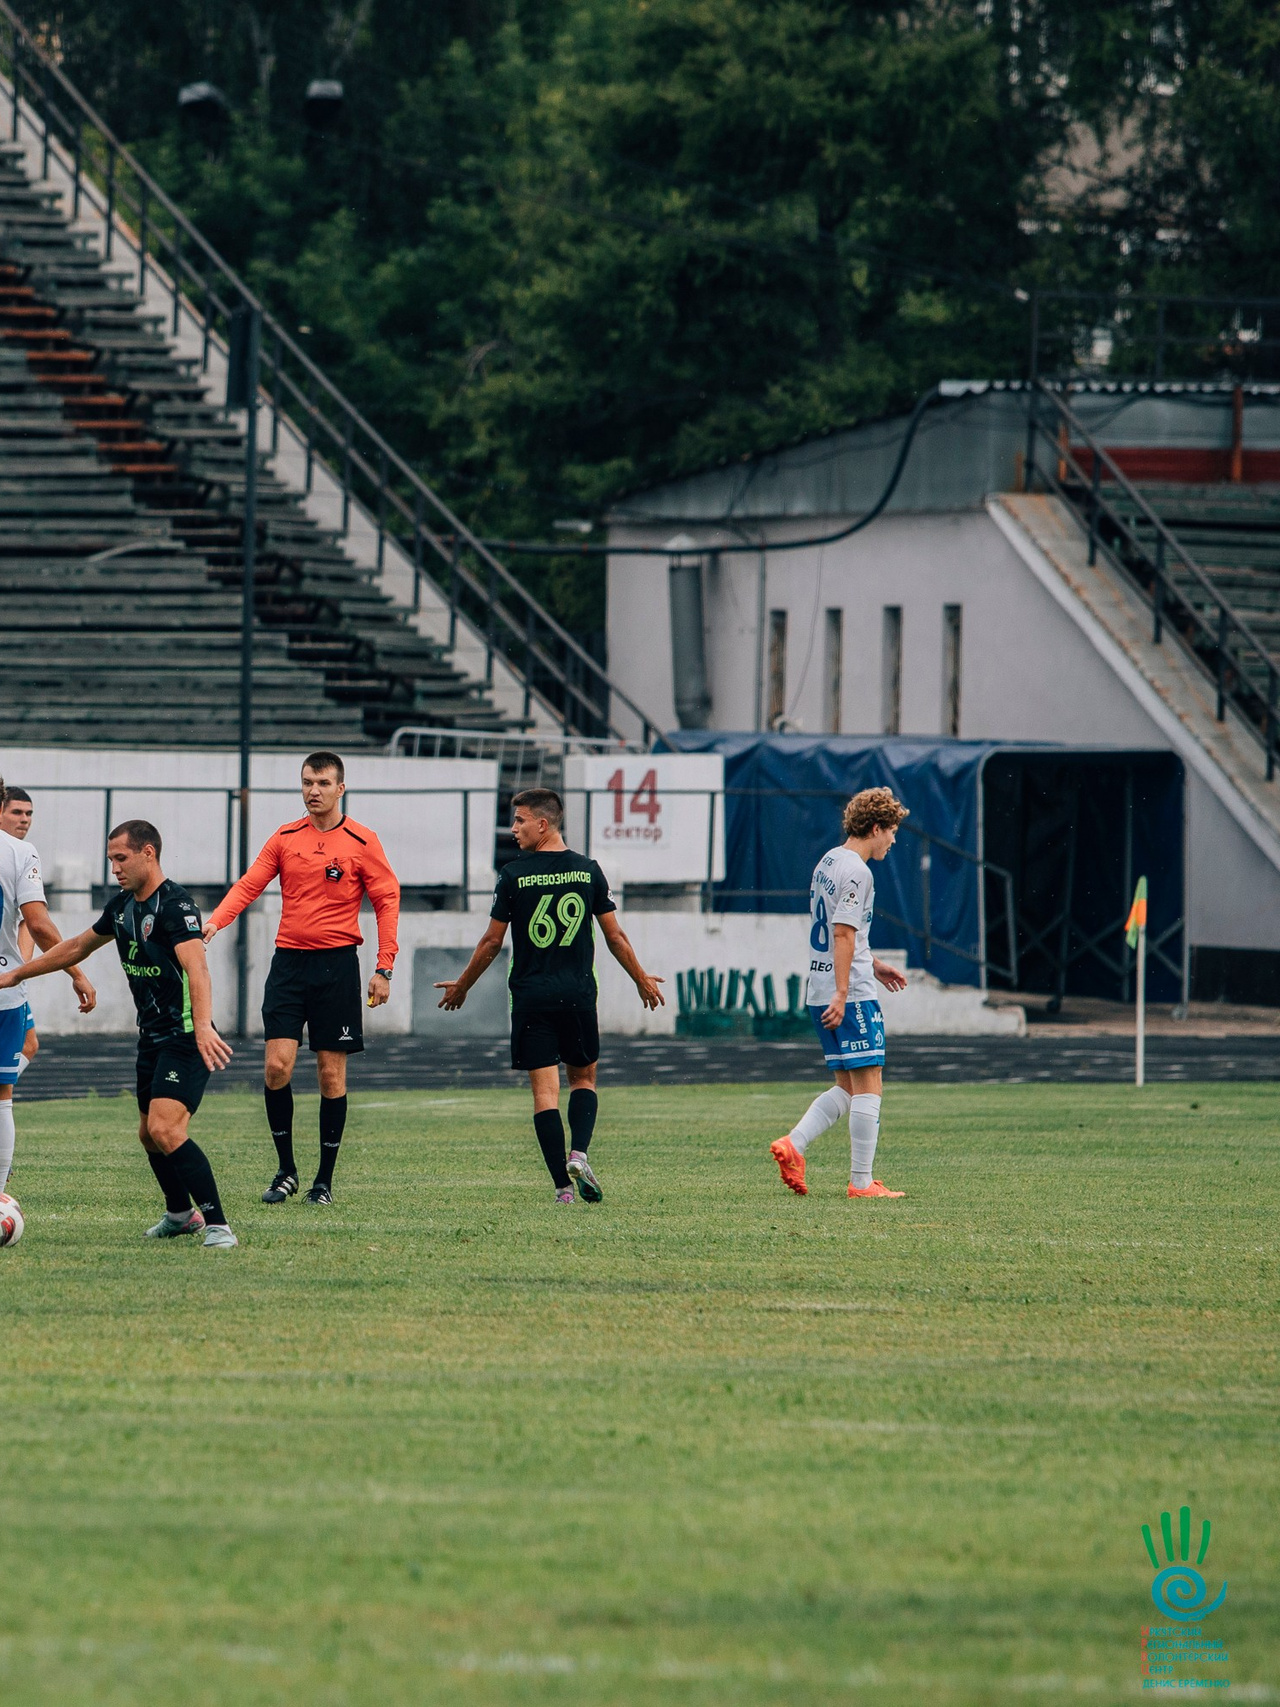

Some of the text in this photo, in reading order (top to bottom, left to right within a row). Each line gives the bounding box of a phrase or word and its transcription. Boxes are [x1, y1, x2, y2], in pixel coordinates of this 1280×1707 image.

[608, 769, 662, 823] 14
[603, 826, 663, 843] сектор
[329, 869, 338, 878] 2
[518, 871, 592, 888] ПЕРЕВОЗНИКОВ
[528, 892, 586, 949] 69
[855, 1001, 868, 1034] BetBoo
[850, 1039, 870, 1051] ВТБ
